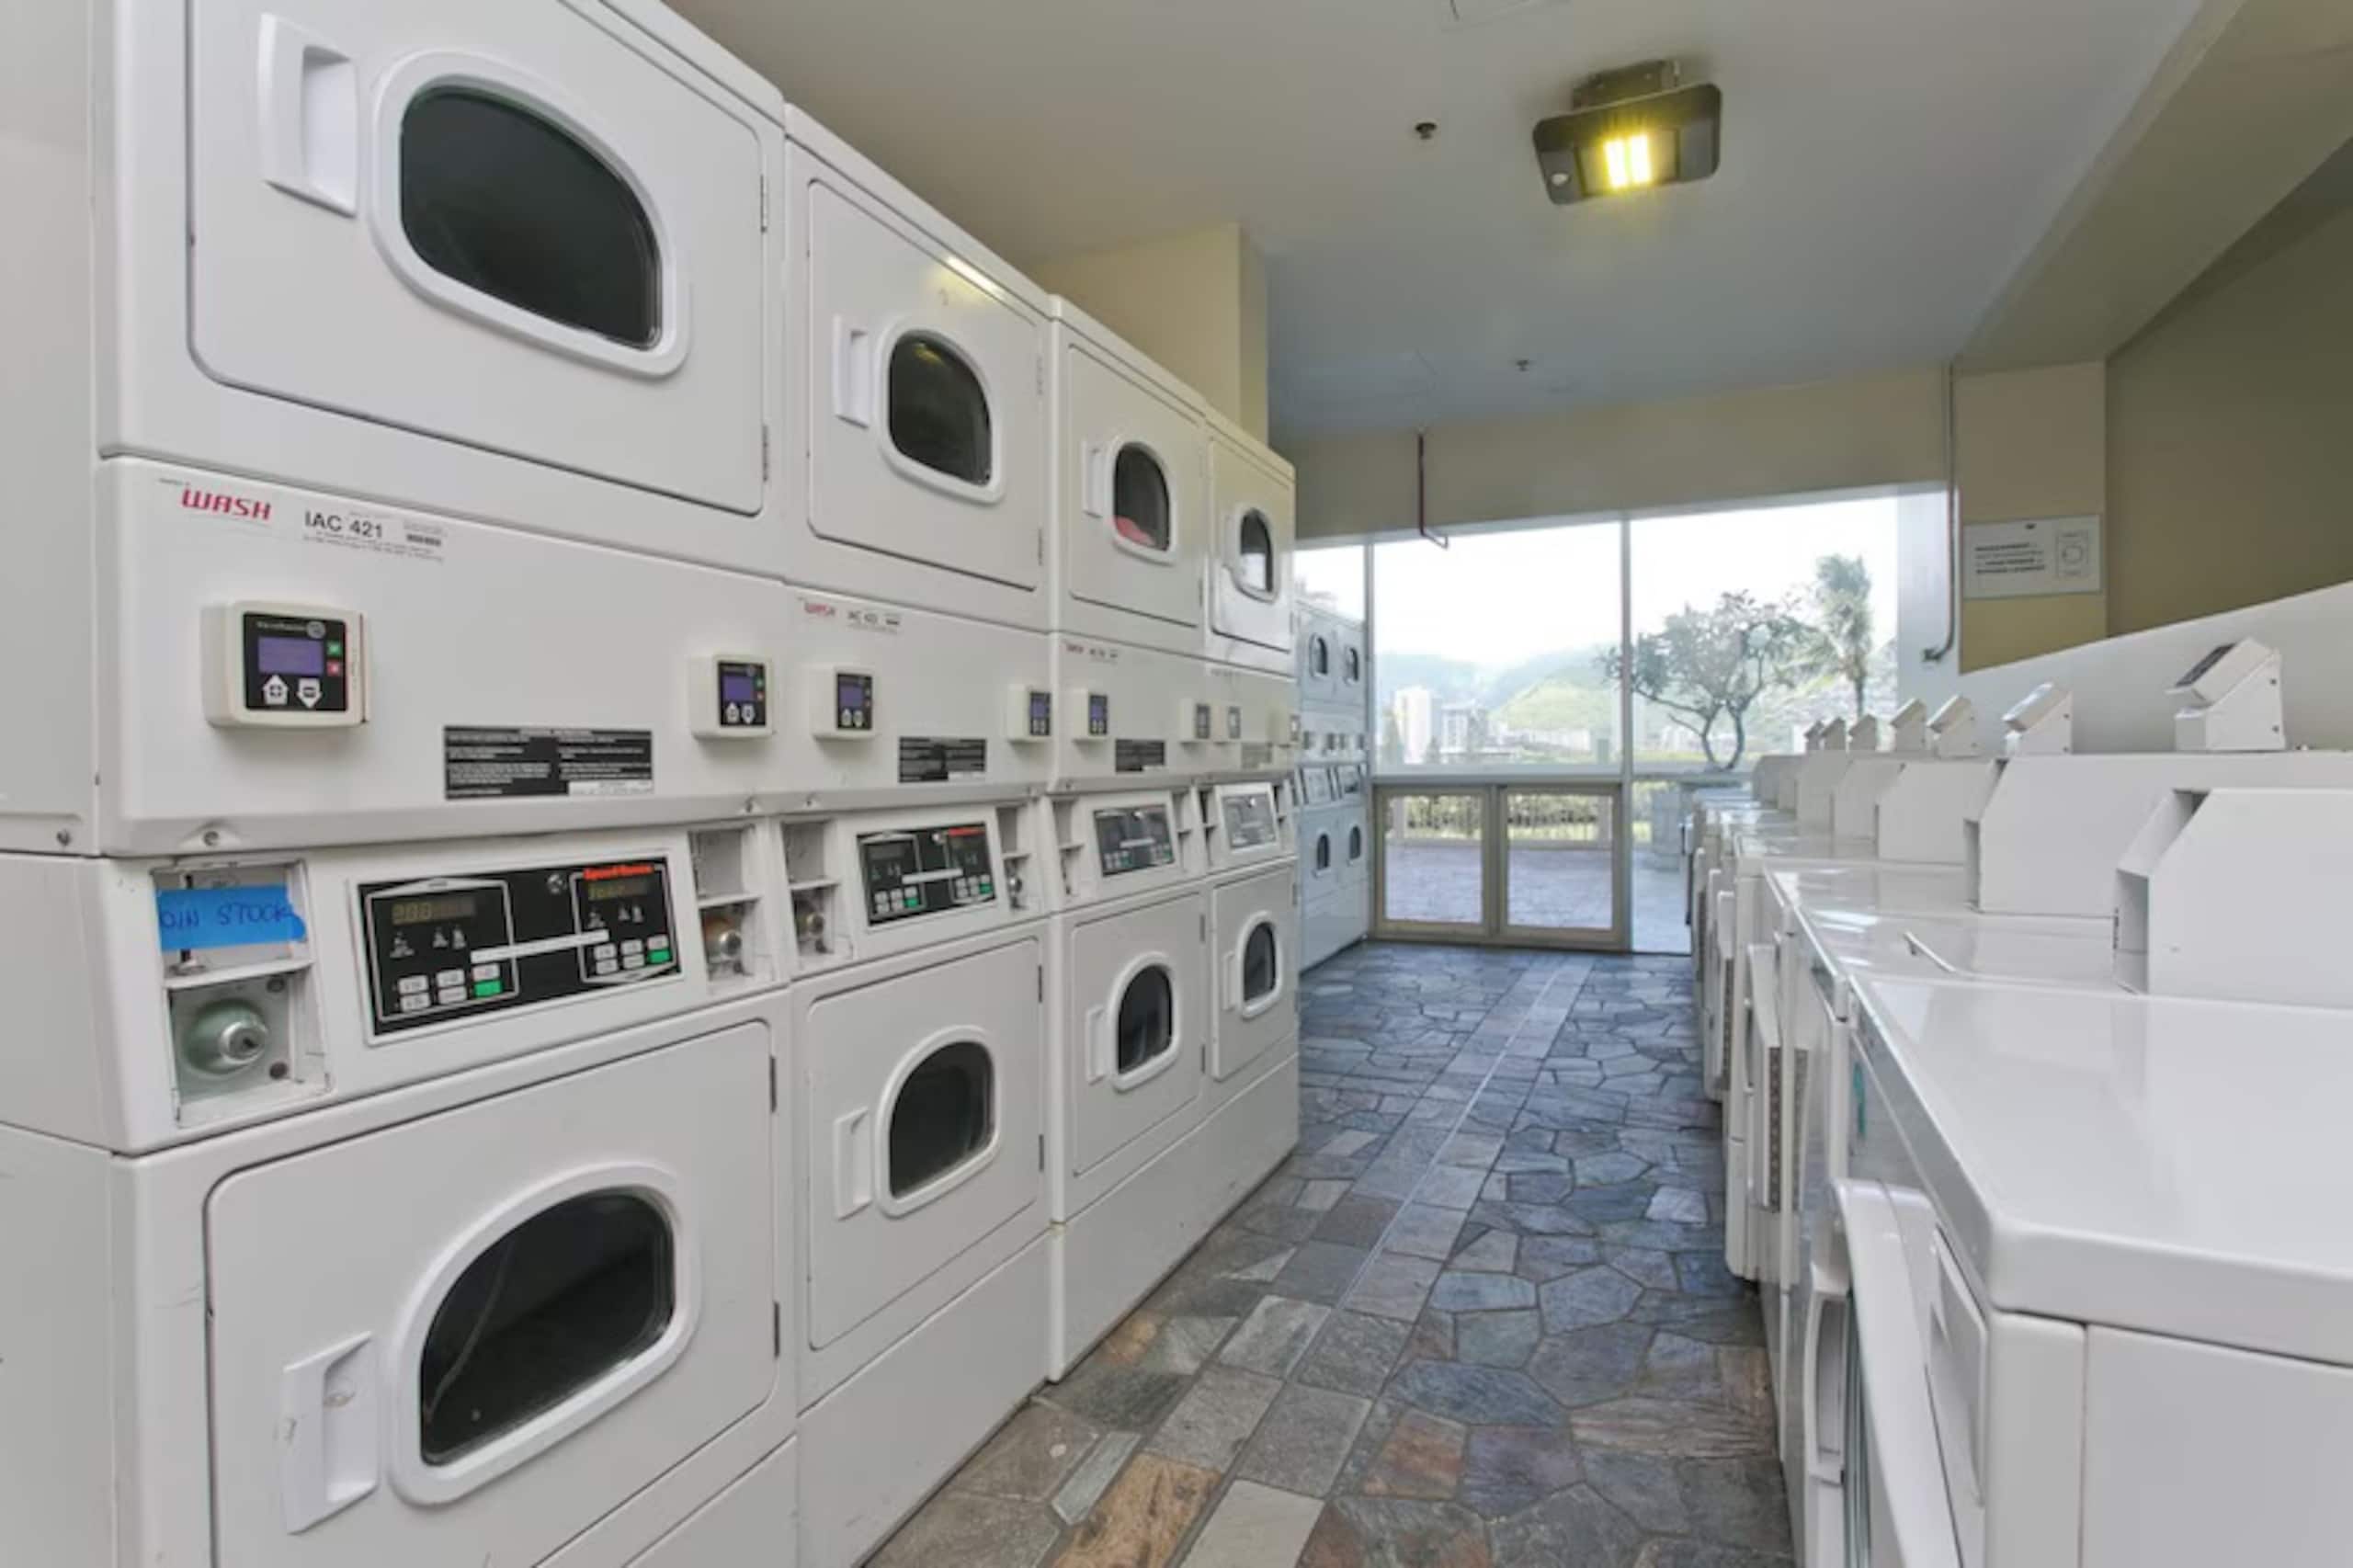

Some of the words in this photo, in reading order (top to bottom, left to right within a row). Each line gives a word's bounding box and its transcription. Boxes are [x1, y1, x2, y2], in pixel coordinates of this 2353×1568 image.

[182, 487, 271, 521] WASH
[304, 510, 343, 532] IAC
[349, 518, 383, 539] 421
